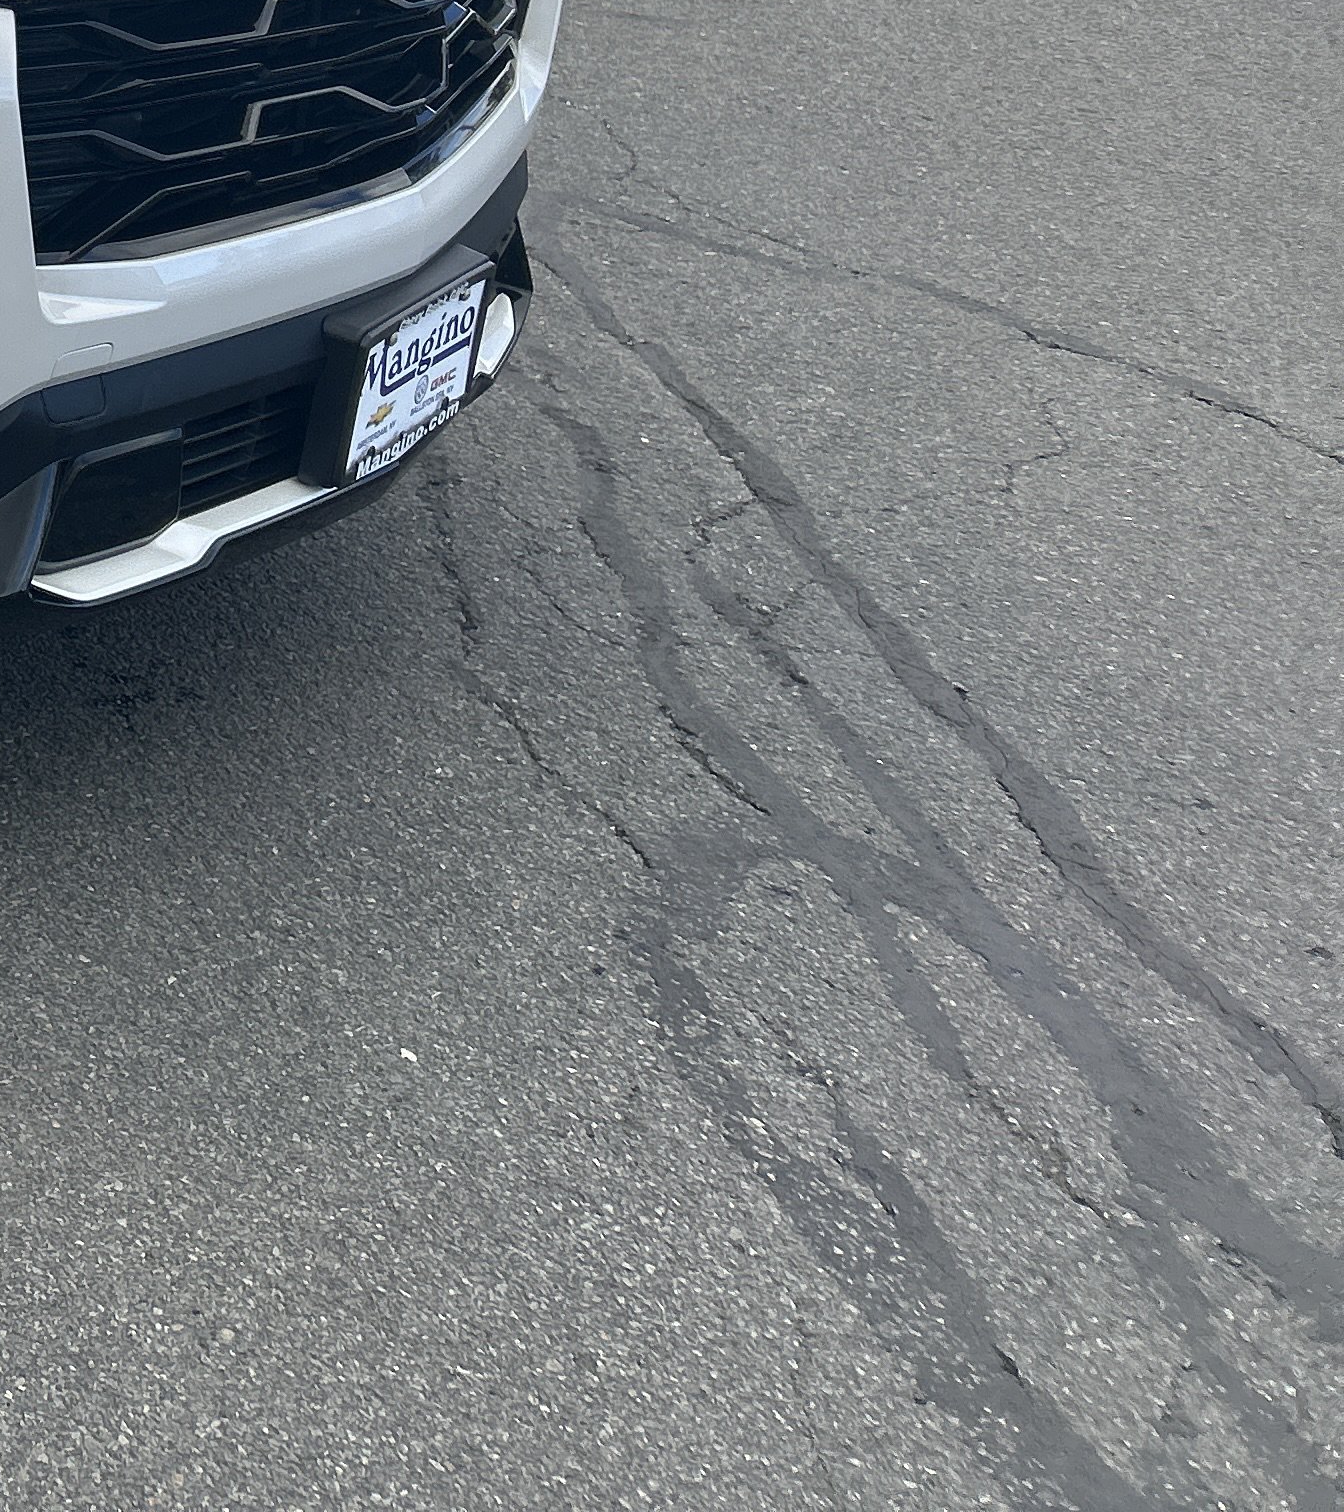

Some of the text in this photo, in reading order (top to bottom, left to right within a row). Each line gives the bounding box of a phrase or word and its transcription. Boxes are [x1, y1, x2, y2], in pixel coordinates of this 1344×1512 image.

[364, 305, 475, 396] Mangino
[430, 367, 457, 391] GMC
[355, 400, 460, 480] Mangino.com
